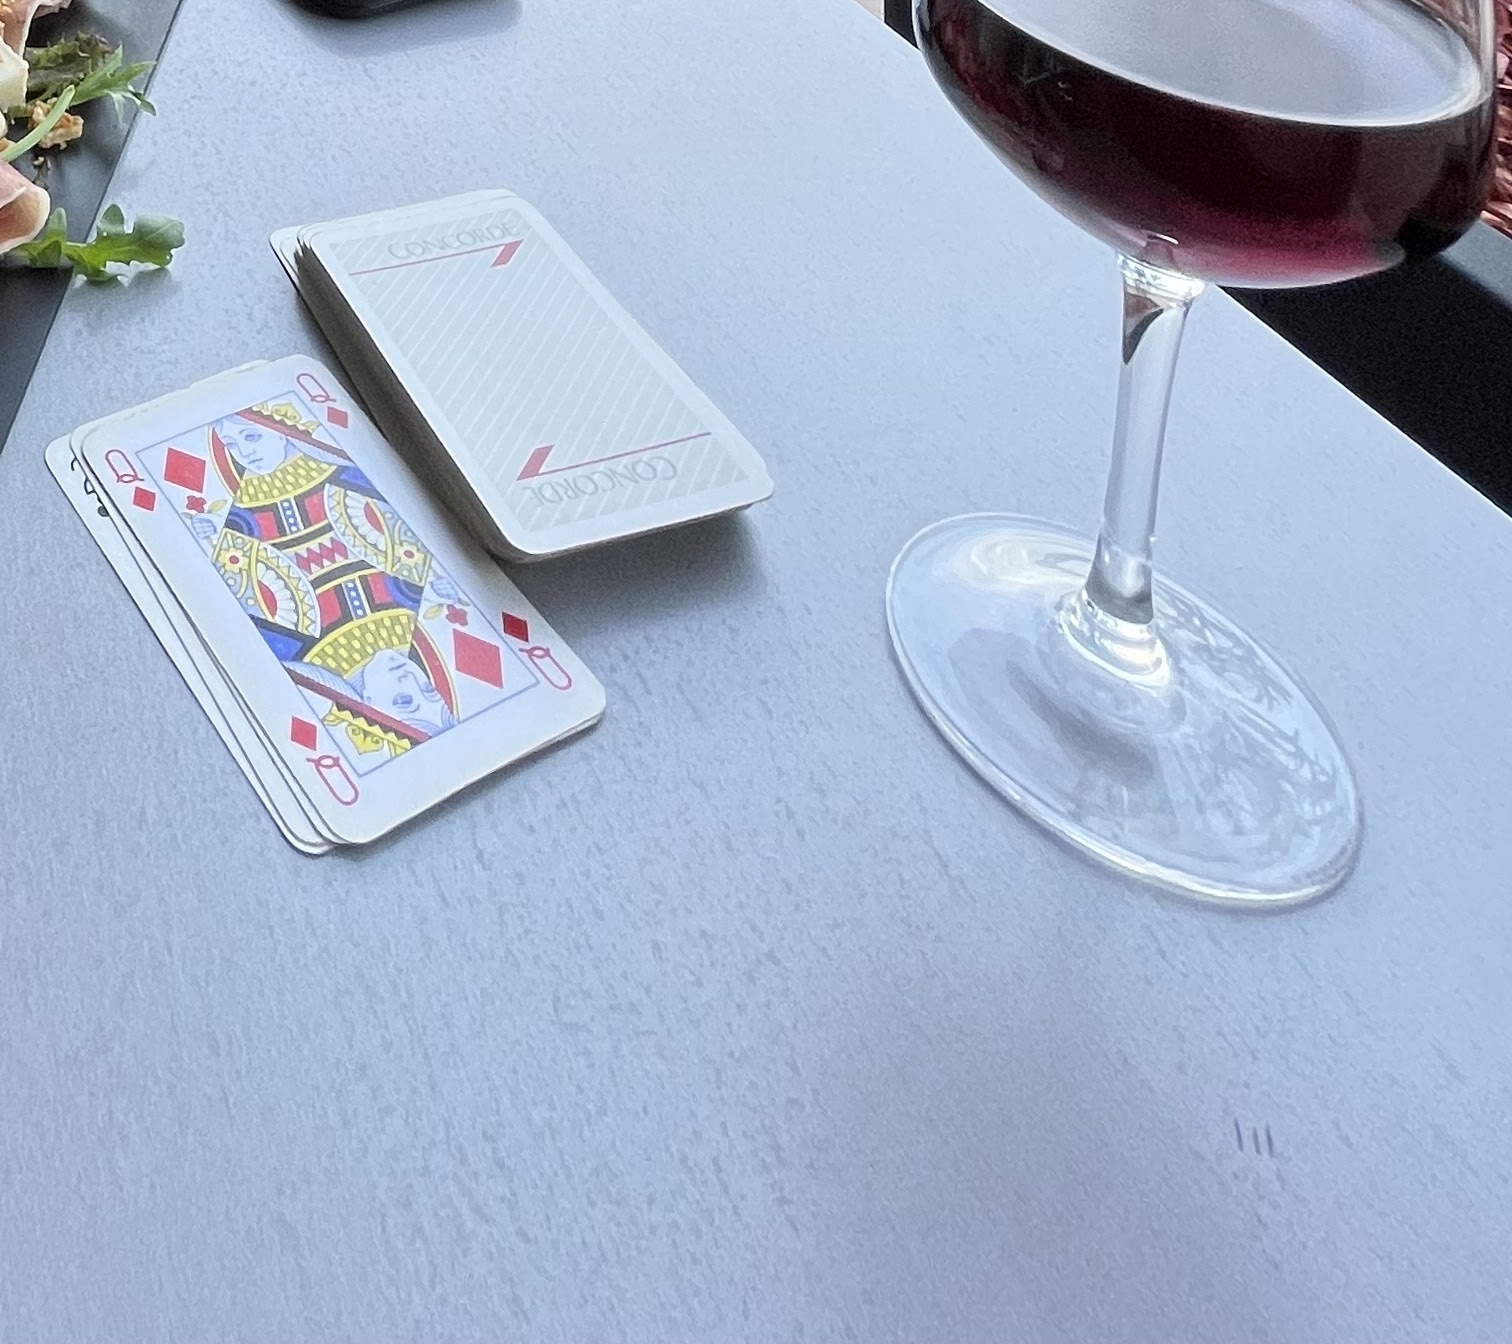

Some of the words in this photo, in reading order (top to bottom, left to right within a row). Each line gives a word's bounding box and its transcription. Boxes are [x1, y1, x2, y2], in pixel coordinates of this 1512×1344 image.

[388, 221, 522, 260] CONCORDE
[296, 372, 337, 404] Q
[105, 448, 145, 484] Q
[521, 455, 678, 507] CONCORDE
[518, 646, 572, 691] Q
[305, 754, 360, 806] Q
